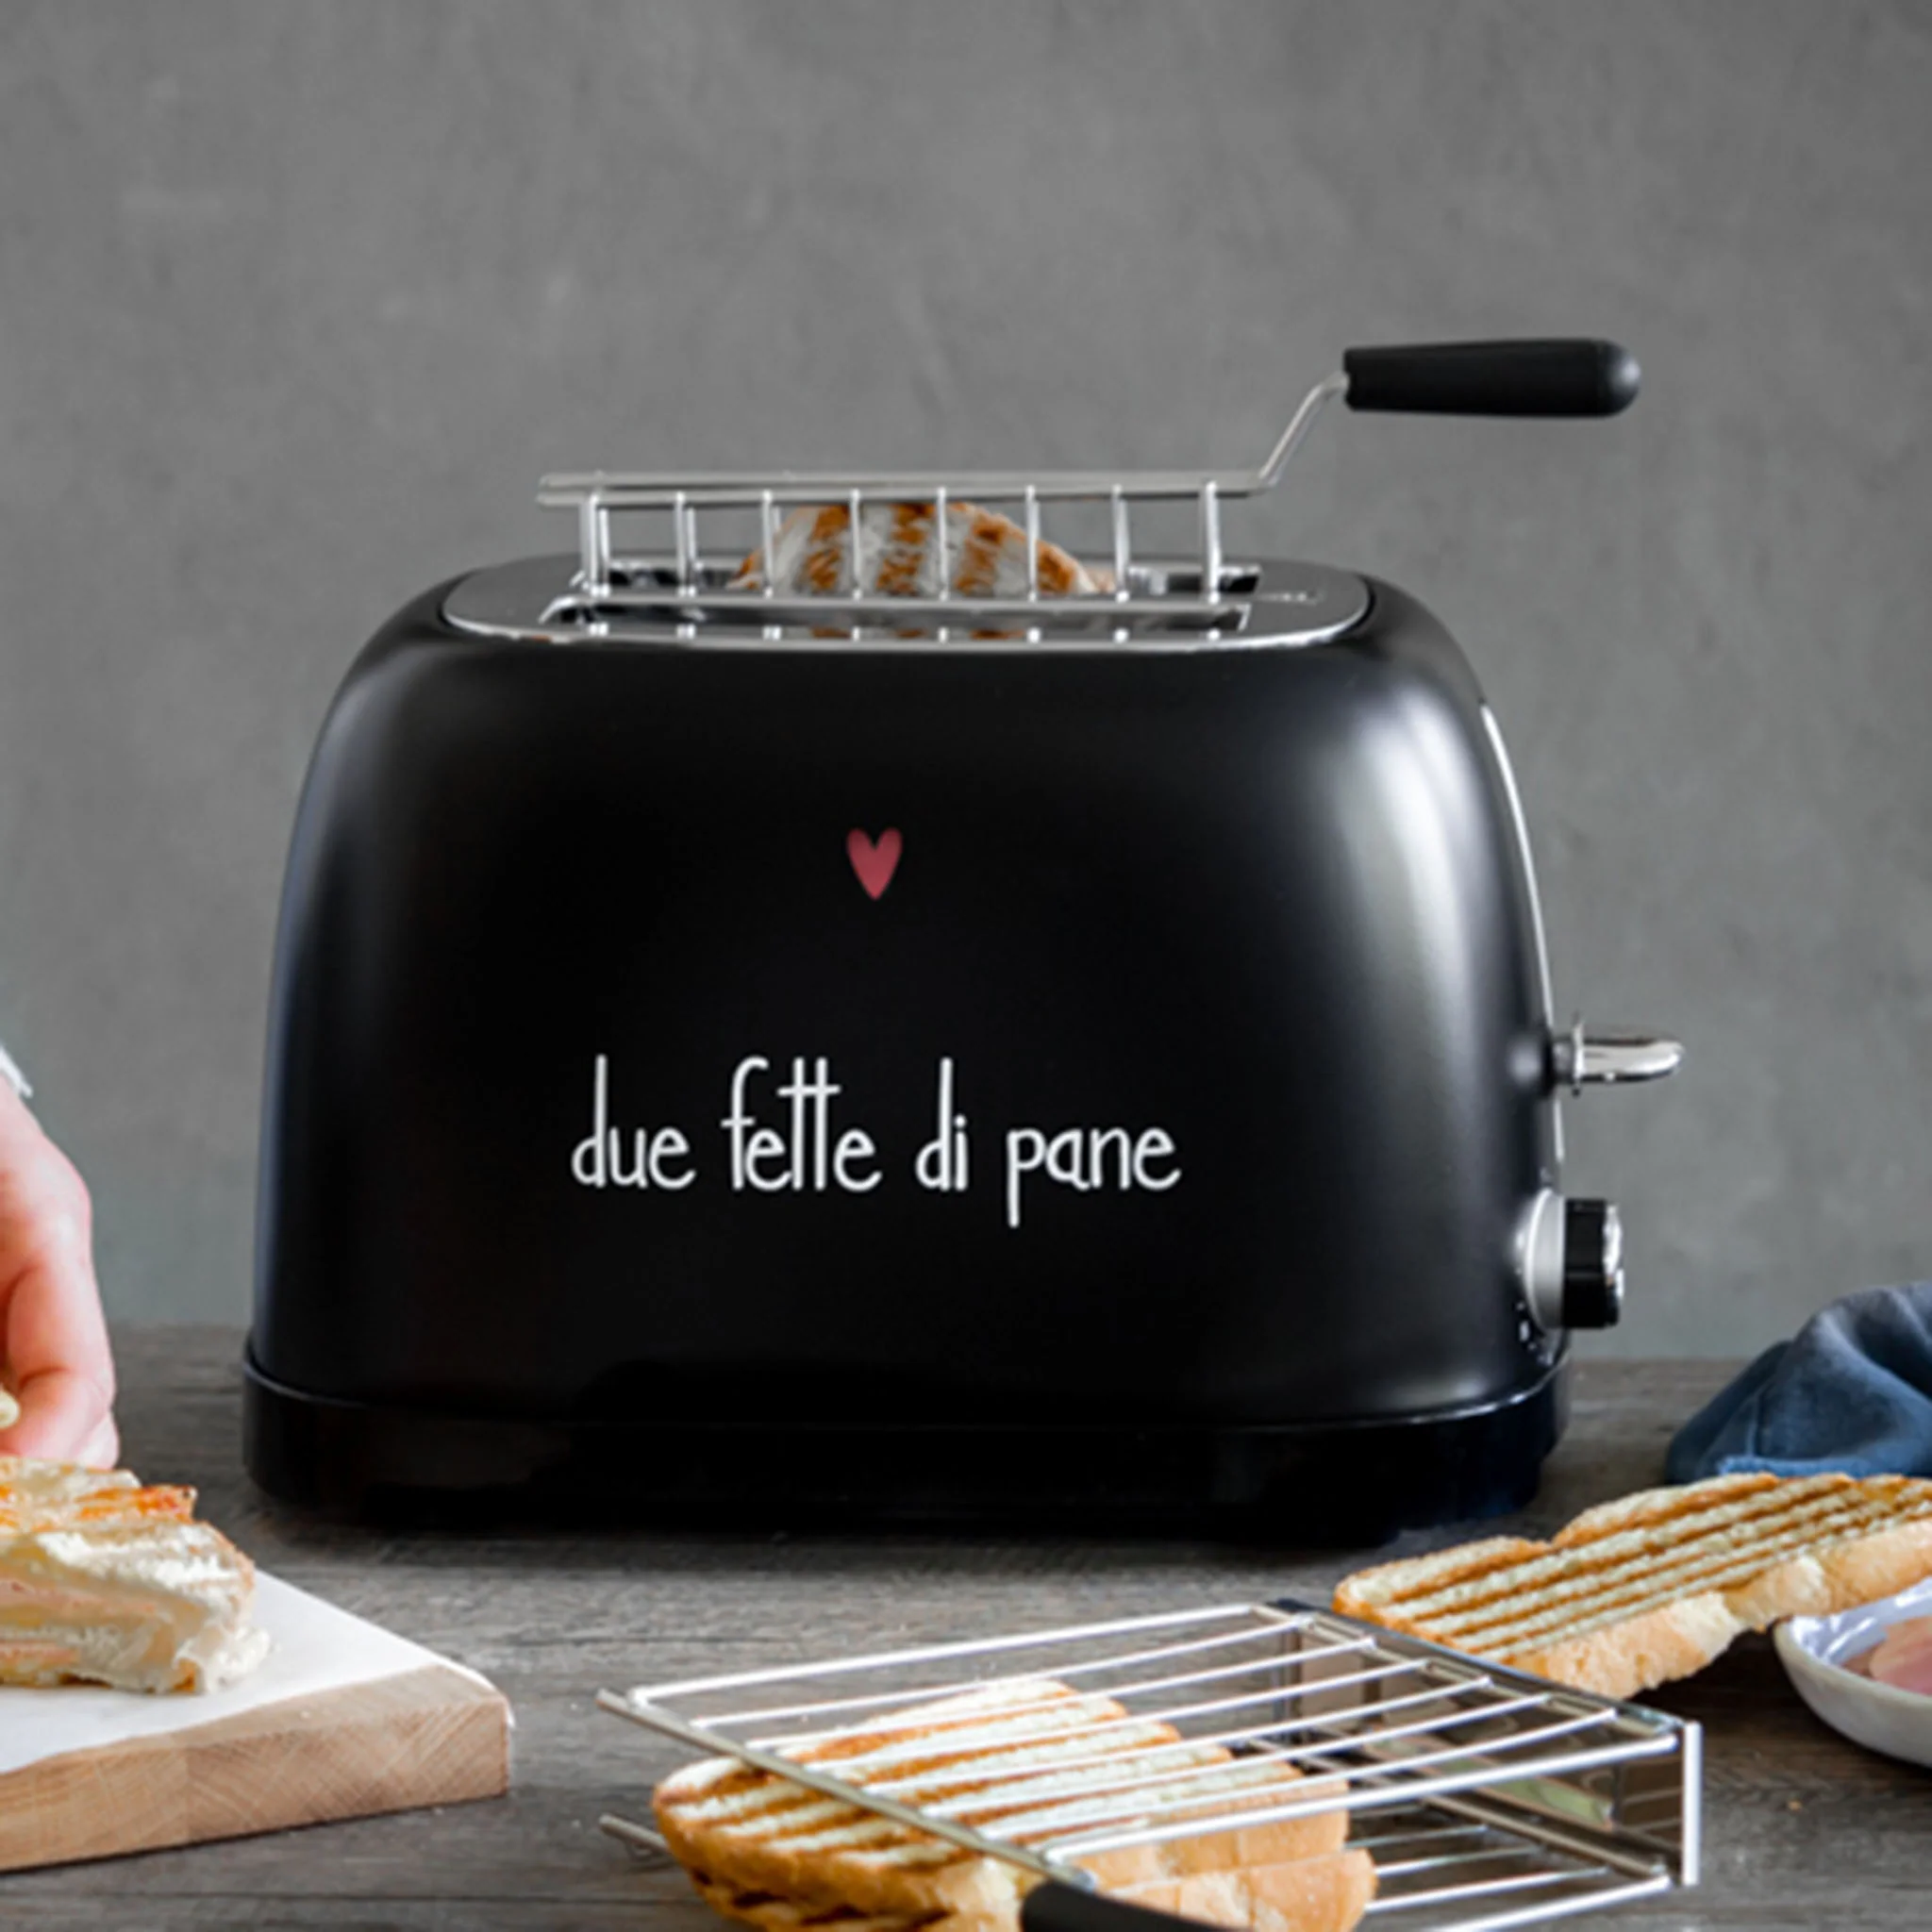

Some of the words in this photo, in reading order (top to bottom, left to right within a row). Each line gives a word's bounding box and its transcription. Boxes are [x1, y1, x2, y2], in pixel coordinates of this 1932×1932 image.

[572, 1055, 695, 1190] due
[721, 1057, 882, 1191] fette
[916, 1058, 968, 1191] di
[1007, 1127, 1181, 1227] pane
